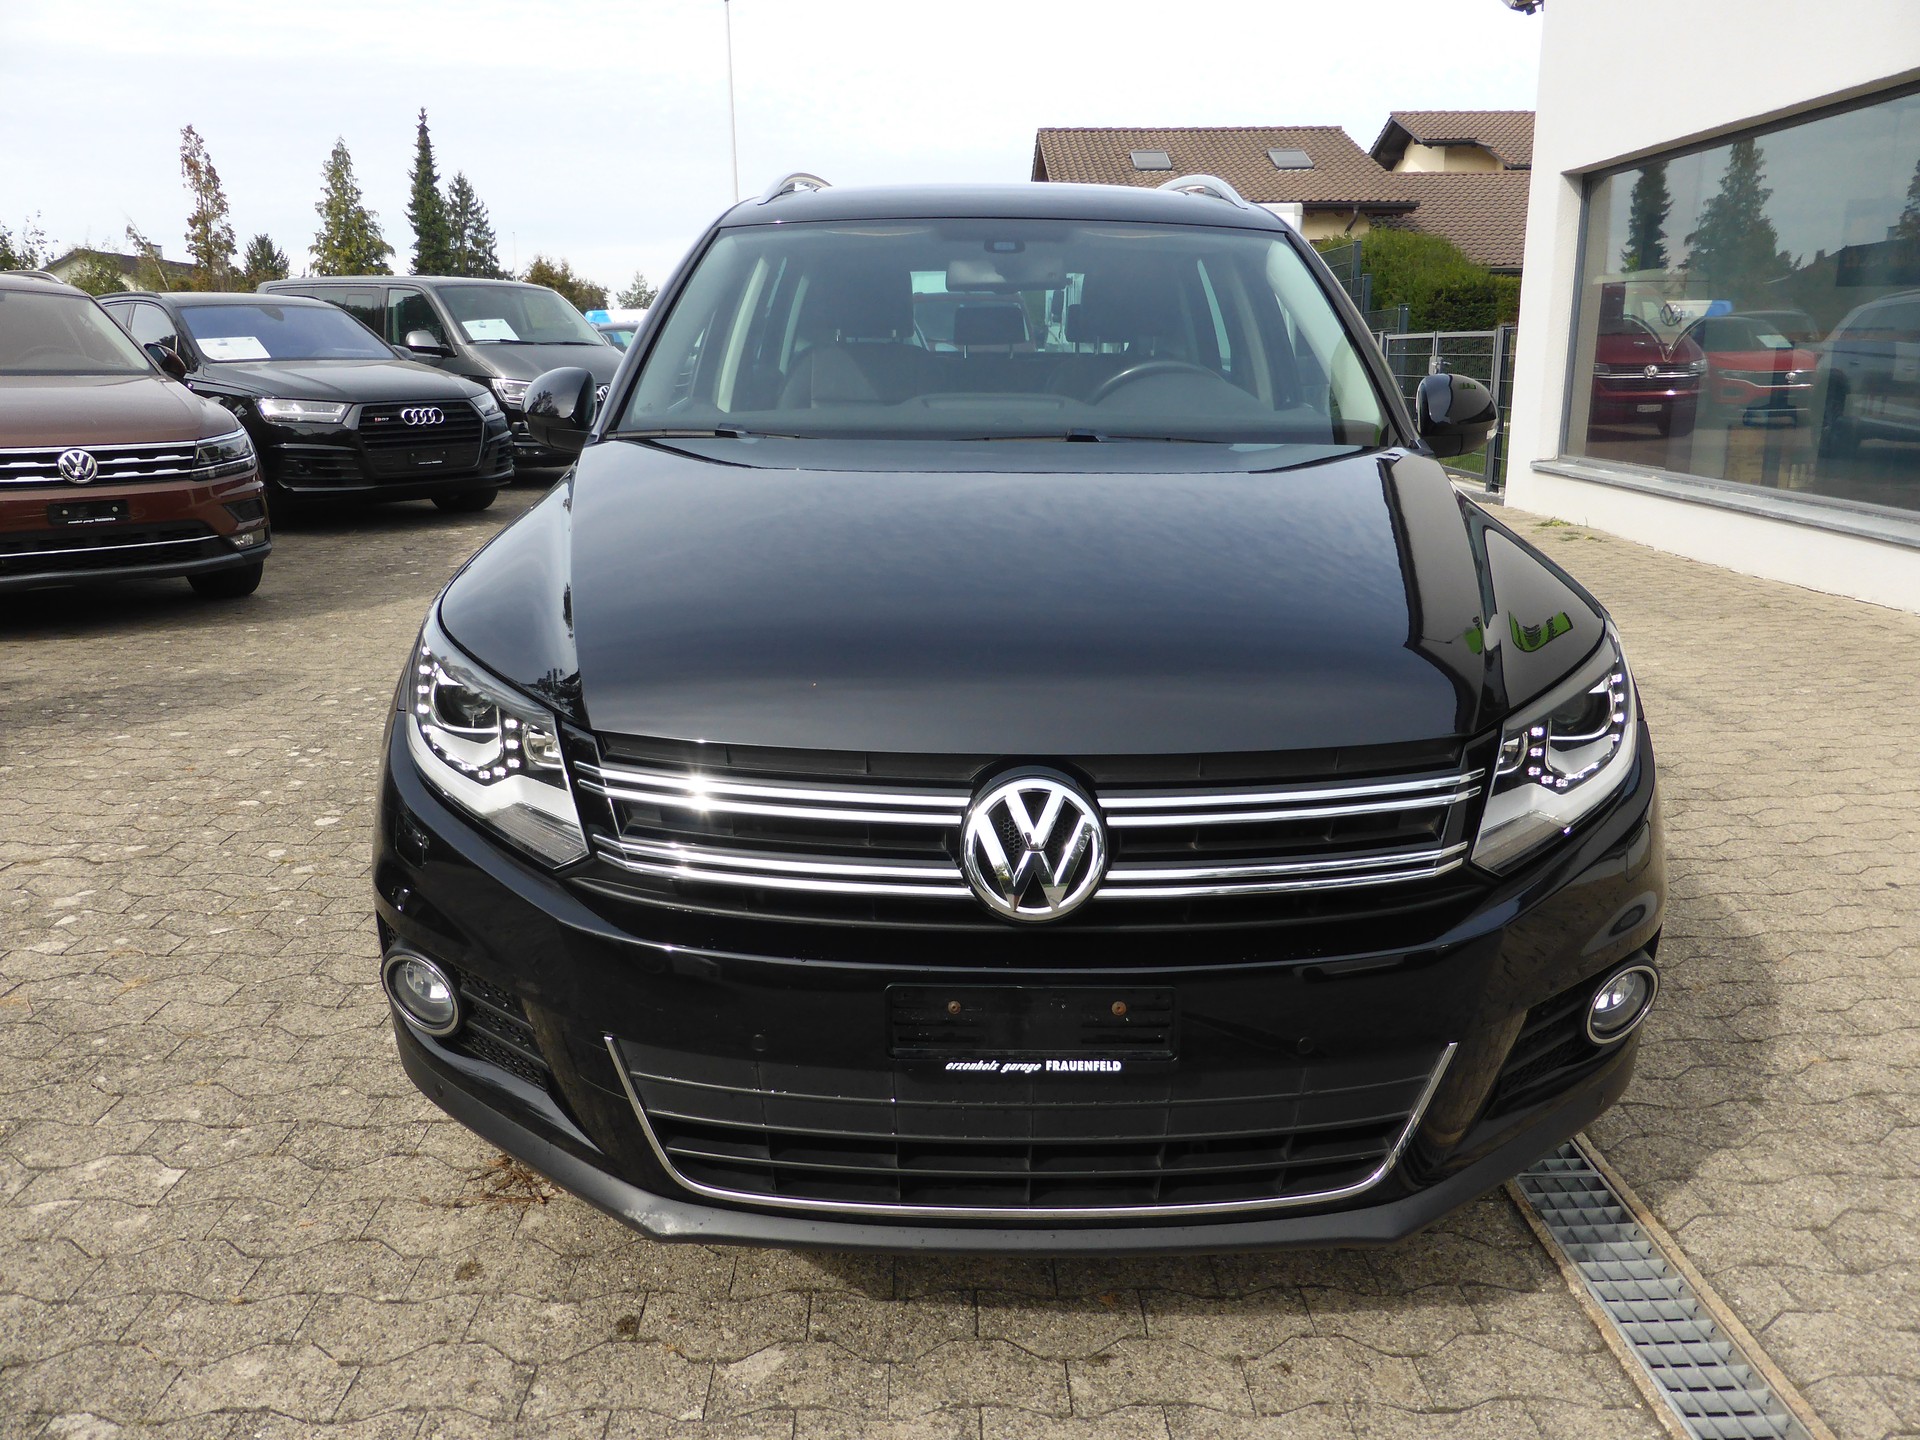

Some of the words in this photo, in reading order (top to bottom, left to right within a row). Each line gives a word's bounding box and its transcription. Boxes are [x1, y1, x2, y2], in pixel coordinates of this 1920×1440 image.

[964, 778, 1106, 922] VW
[1000, 1062, 1042, 1073] garage
[1045, 1060, 1122, 1071] FRAUENFELD
